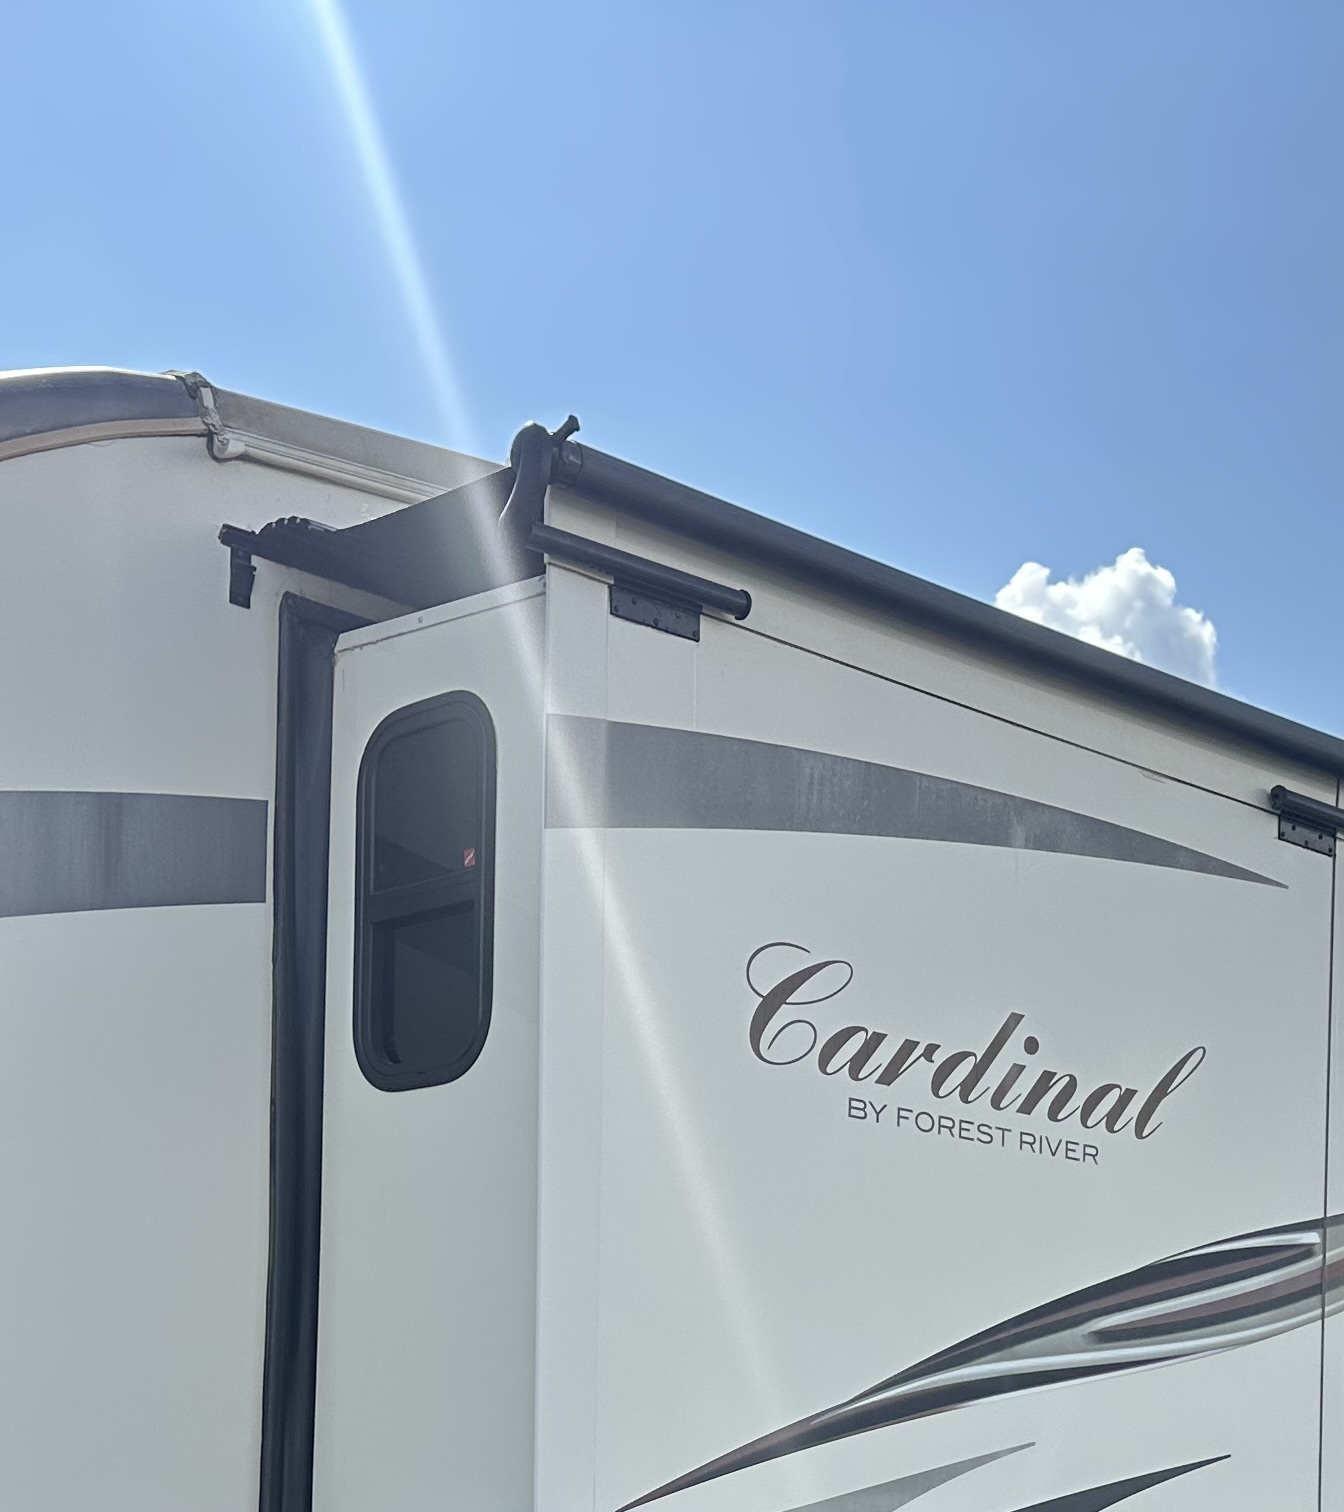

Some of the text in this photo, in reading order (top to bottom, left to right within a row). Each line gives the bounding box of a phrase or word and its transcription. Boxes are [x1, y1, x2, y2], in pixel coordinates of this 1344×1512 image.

[746, 941, 1207, 1140] Cardinal
[847, 1097, 1099, 1165] BY FOREST RIVER
